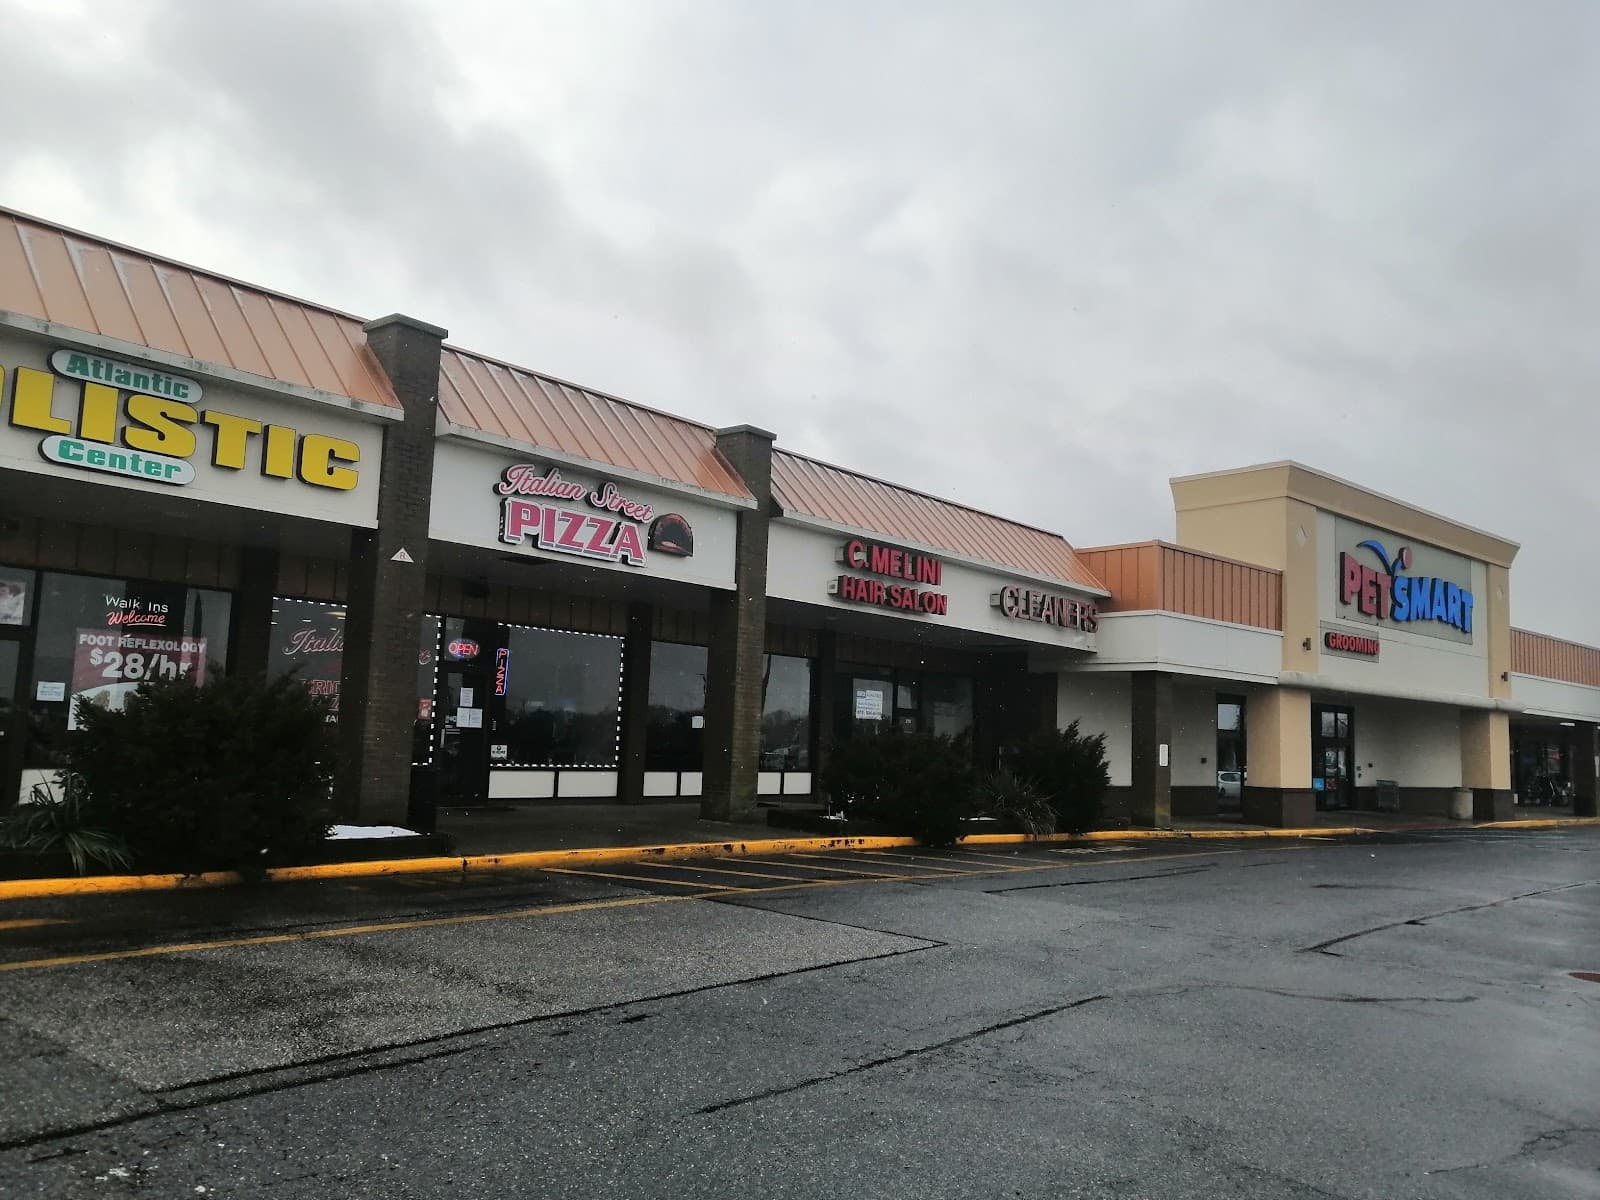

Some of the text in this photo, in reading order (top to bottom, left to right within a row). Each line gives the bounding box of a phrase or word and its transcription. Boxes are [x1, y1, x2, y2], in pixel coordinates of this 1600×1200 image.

[66, 354, 189, 399] Atlantic
[0, 364, 361, 490] LISTIC
[58, 439, 182, 479] Center
[499, 464, 654, 523] Italian Street
[504, 498, 647, 567] PIZZA
[871, 546, 943, 586] MELINI
[105, 595, 140, 609] Walk
[842, 575, 948, 615] HAIR SALON
[1002, 585, 1099, 633] CLEANERS
[106, 610, 166, 626] Welcome
[79, 633, 207, 653] FOOT REFLEXOLOGY
[448, 642, 479, 657] OPEN
[1327, 632, 1380, 656] GROOMING
[495, 650, 507, 693] PIZZA
